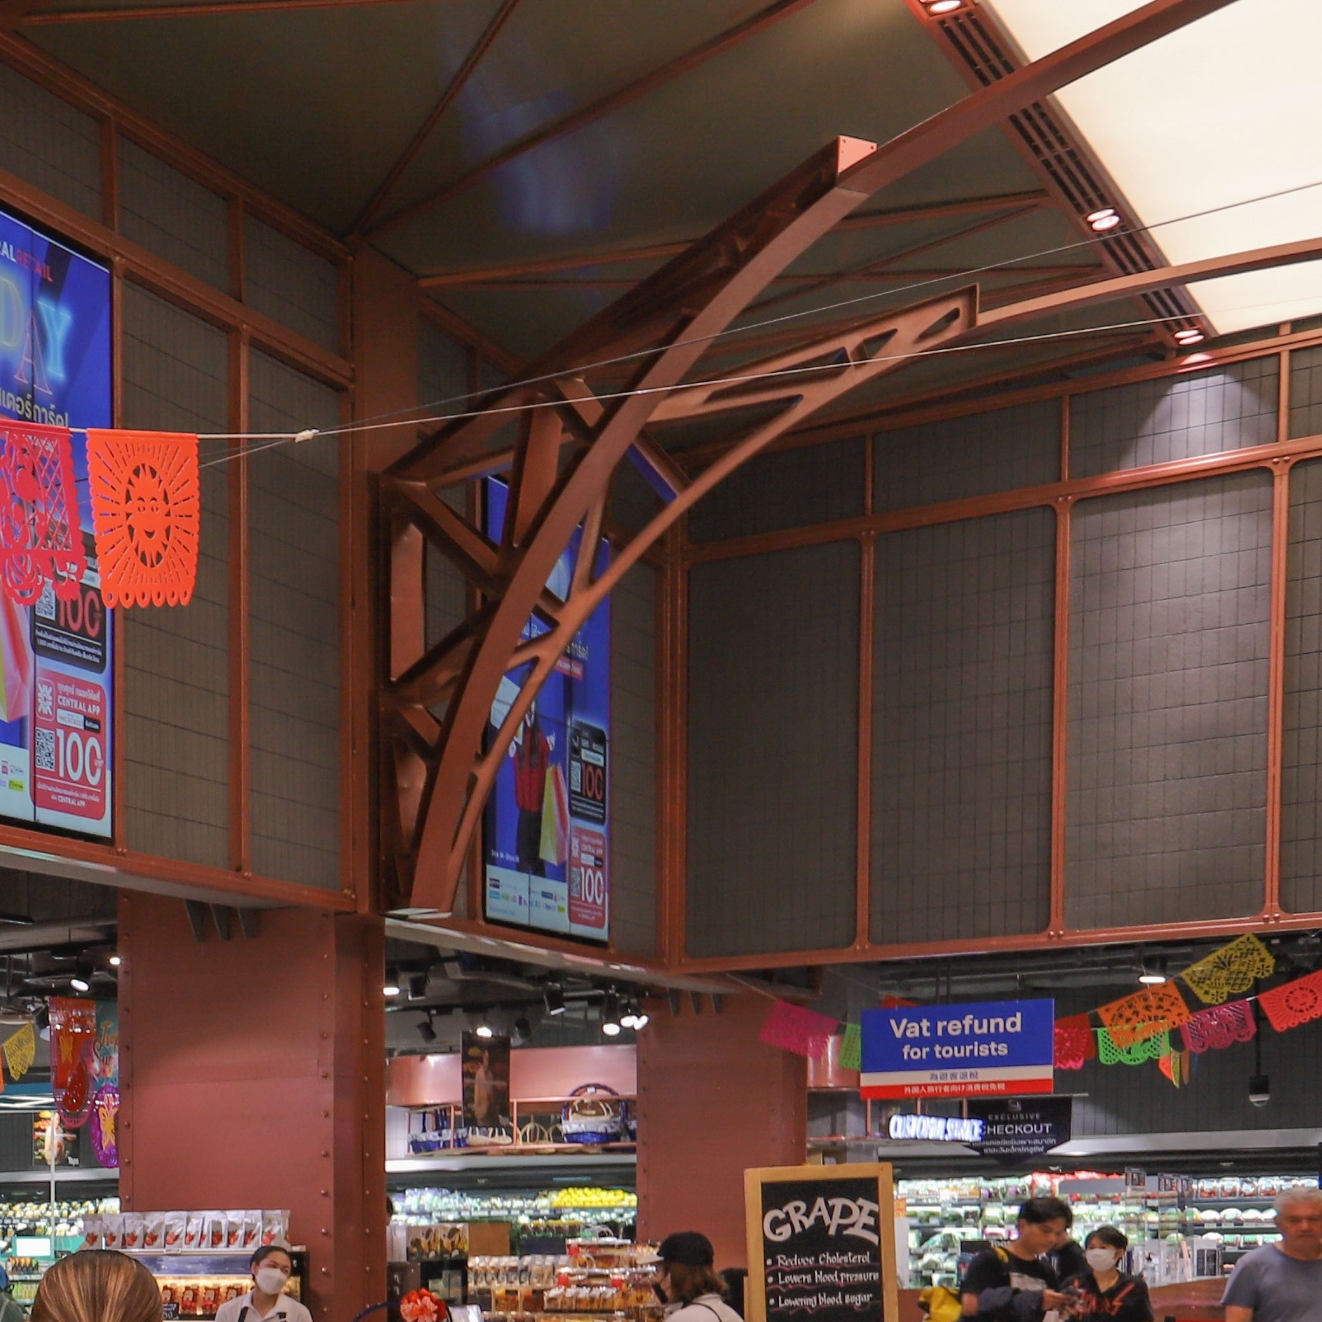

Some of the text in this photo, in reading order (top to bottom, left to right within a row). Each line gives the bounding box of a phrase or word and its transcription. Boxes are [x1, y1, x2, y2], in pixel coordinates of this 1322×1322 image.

[58, 695, 101, 716] CENTRAL APP
[889, 1011, 1022, 1039] Vat refund
[902, 1041, 1008, 1060] for tourists
[988, 1112, 1042, 1122] EXCLUSIVE
[763, 1196, 880, 1246] GRAPE
[776, 1252, 871, 1266] Reduce Cholesterol
[778, 1270, 879, 1285] Lowers blood pressure
[778, 1291, 873, 1309] Lowering blood sugar
